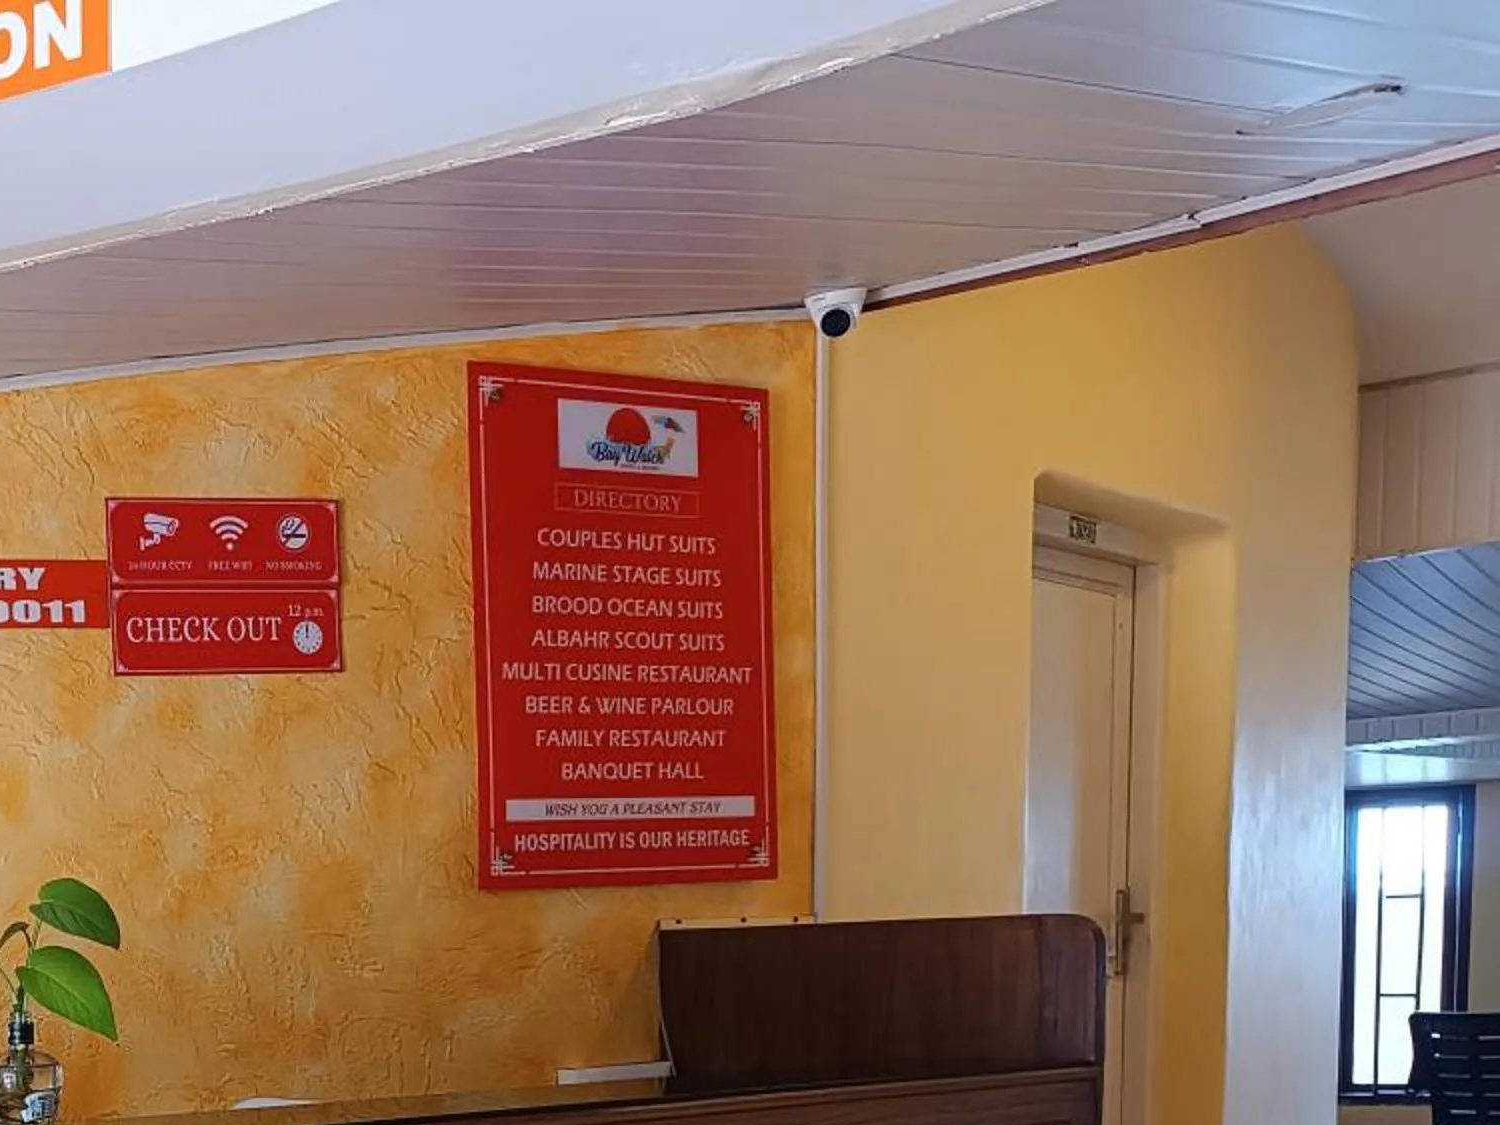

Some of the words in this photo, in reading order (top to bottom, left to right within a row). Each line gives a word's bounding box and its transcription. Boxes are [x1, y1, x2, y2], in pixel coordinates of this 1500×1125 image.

[573, 488, 682, 514] DIRECTORY
[537, 528, 622, 550] COUPLES
[627, 532, 666, 552] HUT
[669, 535, 717, 555] SUITS
[532, 562, 607, 584] MARINE
[612, 565, 671, 586] STAGE
[675, 568, 722, 588] SUITS
[288, 604, 301, 617] 12
[532, 596, 601, 615] BROOD
[607, 598, 673, 618] OCEAN
[678, 600, 723, 620] SUITS
[126, 616, 221, 643] CHECK
[226, 616, 282, 642] OUT
[531, 630, 609, 650] ALBAHR
[614, 632, 674, 651] SCOUT
[679, 632, 725, 652] SUITS
[502, 662, 561, 682] MULTI
[566, 663, 633, 682] CUSINE
[637, 664, 753, 685] RESTAURANT
[525, 696, 573, 715] BEER
[578, 697, 591, 715] &
[596, 697, 646, 715] WINE
[651, 698, 734, 716] PARLOUR
[535, 729, 604, 747] FAMILY
[609, 729, 726, 748] RESTAURANT
[561, 762, 654, 781] BANQUET
[658, 762, 704, 780] HALL
[545, 803, 578, 816] WISH
[609, 803, 619, 815] A
[621, 802, 688, 815] PLEASANT
[689, 801, 721, 814] STAY
[514, 831, 615, 852] HOSPITALITY
[619, 831, 635, 850] IS
[639, 830, 671, 849] OUR
[675, 829, 750, 848] HERITAGE
